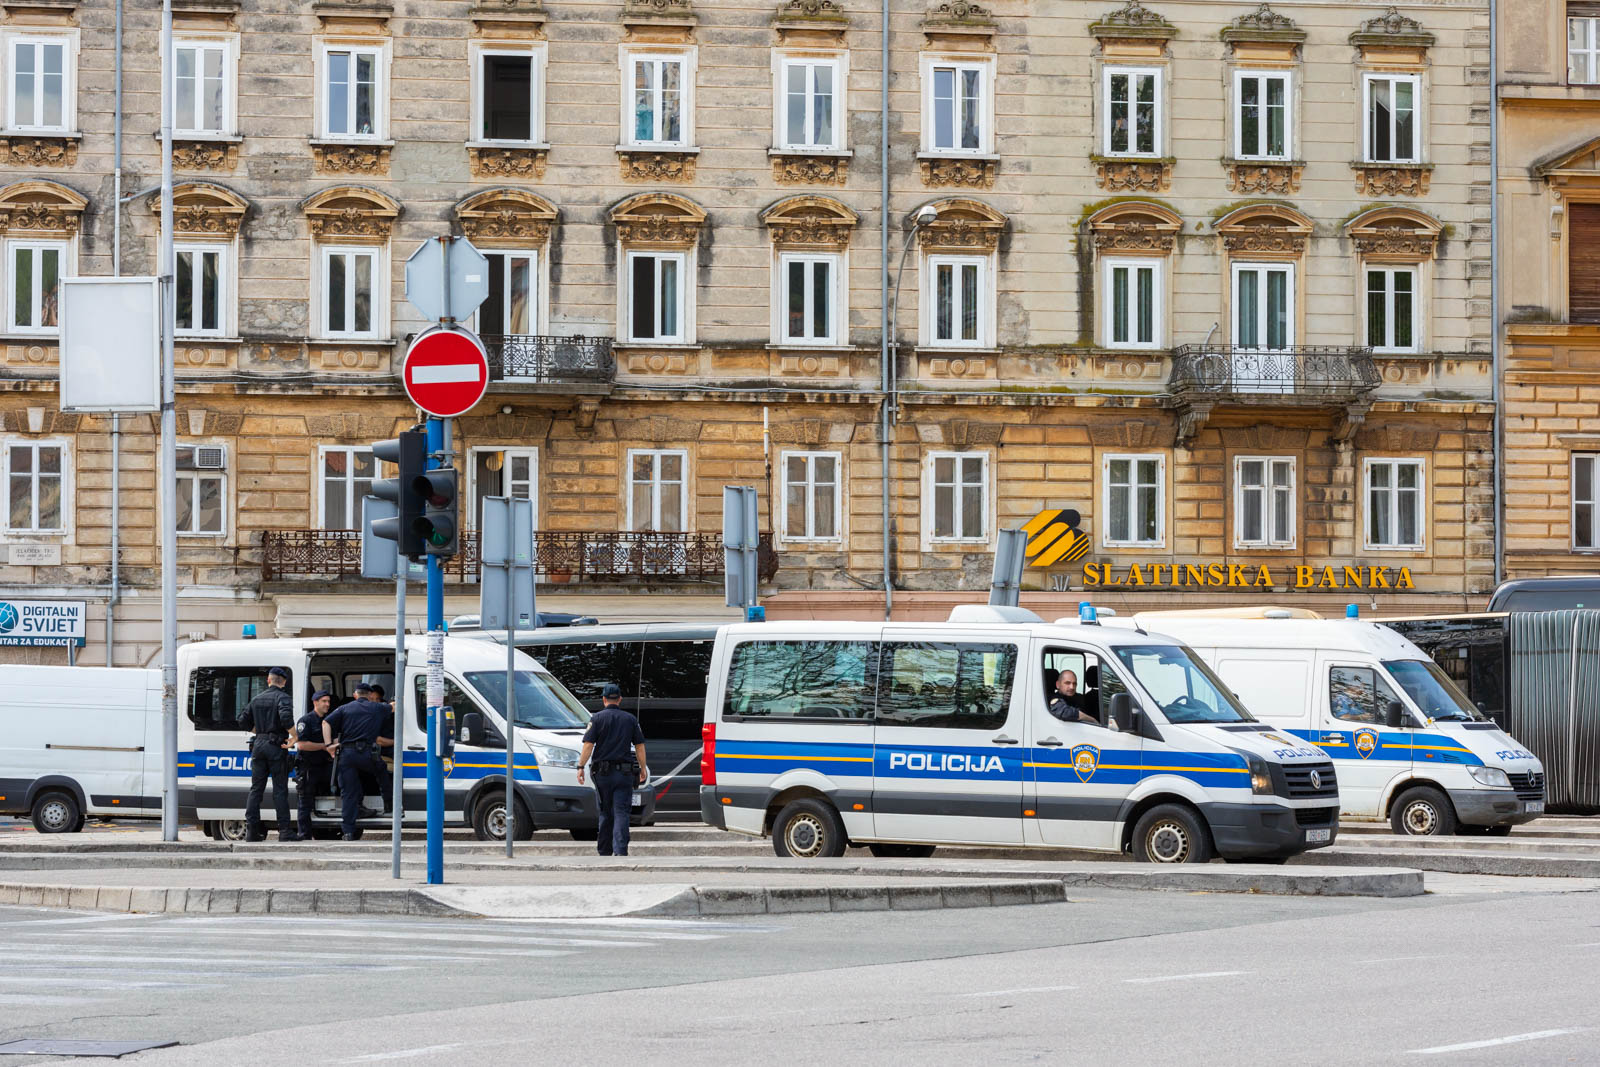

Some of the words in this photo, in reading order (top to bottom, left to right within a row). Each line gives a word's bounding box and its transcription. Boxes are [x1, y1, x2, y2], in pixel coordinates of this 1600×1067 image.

[1083, 561, 1274, 587] SLATINSKA
[1295, 564, 1416, 589] BANKA
[23, 606, 78, 617] DIGITALNI
[23, 618, 78, 632] SVIJET
[1073, 746, 1099, 754] POLICIJA
[1273, 748, 1329, 759] POLICIJA
[889, 752, 1006, 773] POLICIJA
